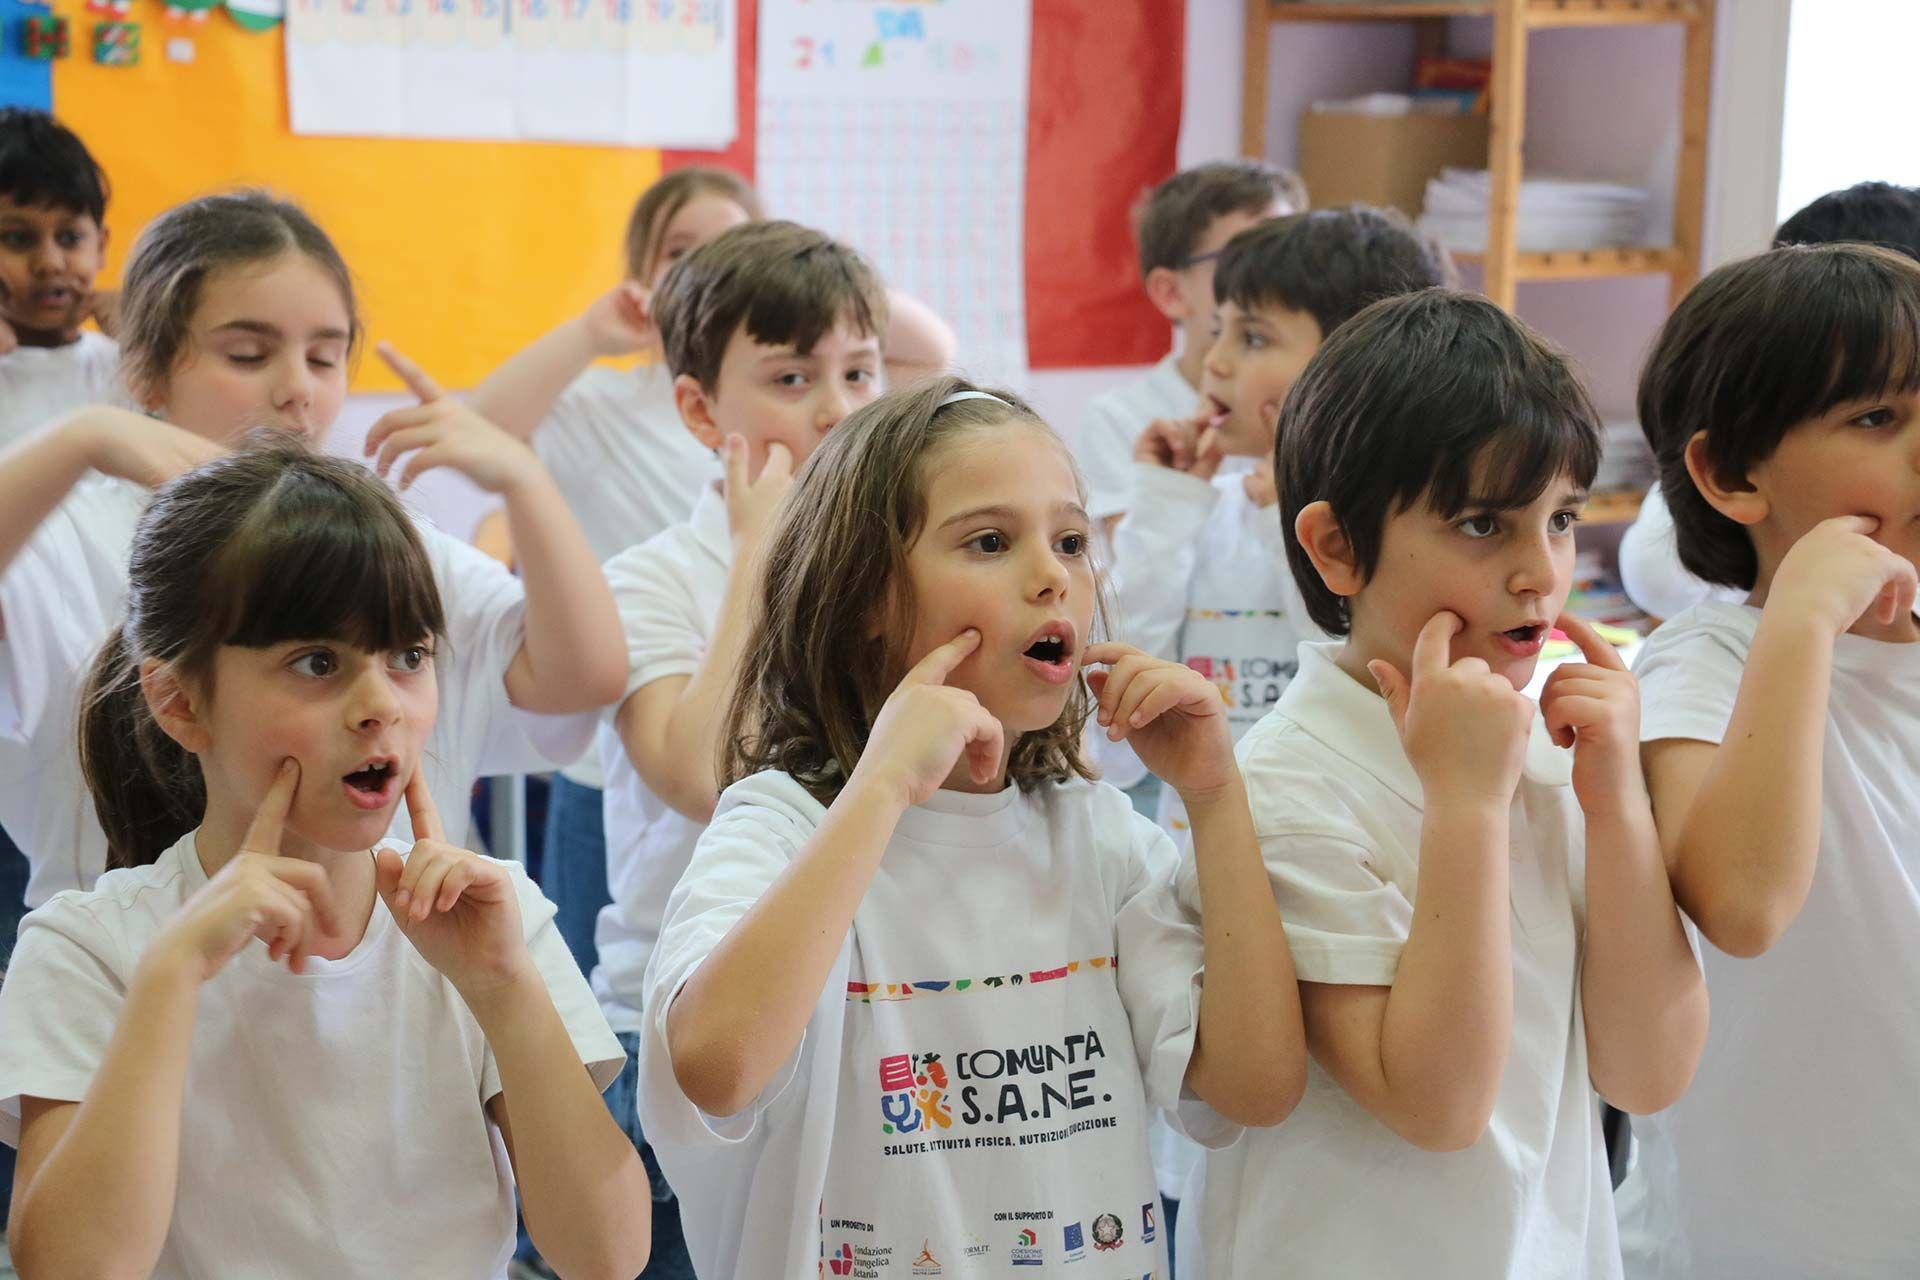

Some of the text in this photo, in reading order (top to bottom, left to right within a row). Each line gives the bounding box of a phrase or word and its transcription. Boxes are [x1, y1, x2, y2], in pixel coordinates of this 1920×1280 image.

[993, 1212, 1007, 1221] CON
[1014, 1211, 1047, 1221] SUPPORTO
[830, 1219, 841, 1229] UN
